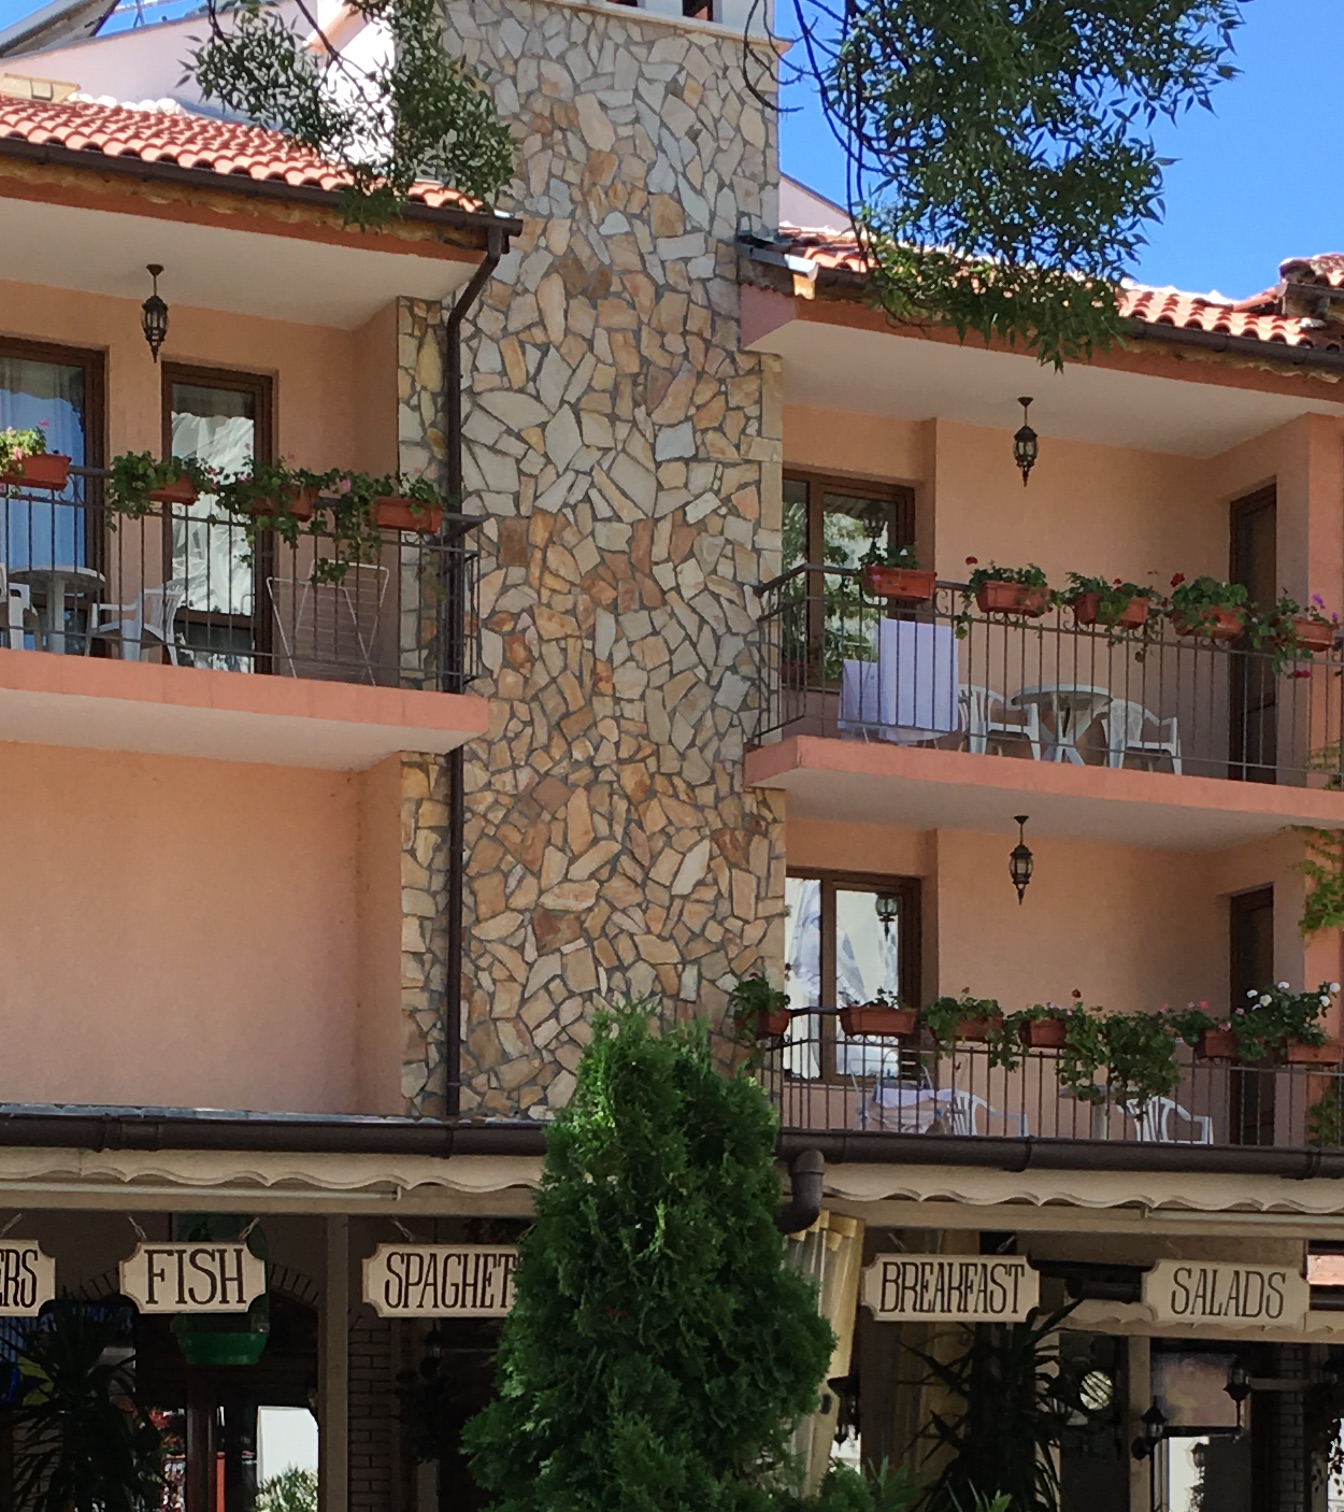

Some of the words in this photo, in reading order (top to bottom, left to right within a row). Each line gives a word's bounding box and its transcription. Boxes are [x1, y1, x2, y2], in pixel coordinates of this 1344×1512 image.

[144, 1248, 246, 1305] FISH
[384, 1251, 519, 1309] SPAGHET
[879, 1261, 1026, 1314] BREAKFAST
[1171, 1268, 1288, 1320] SALADS
